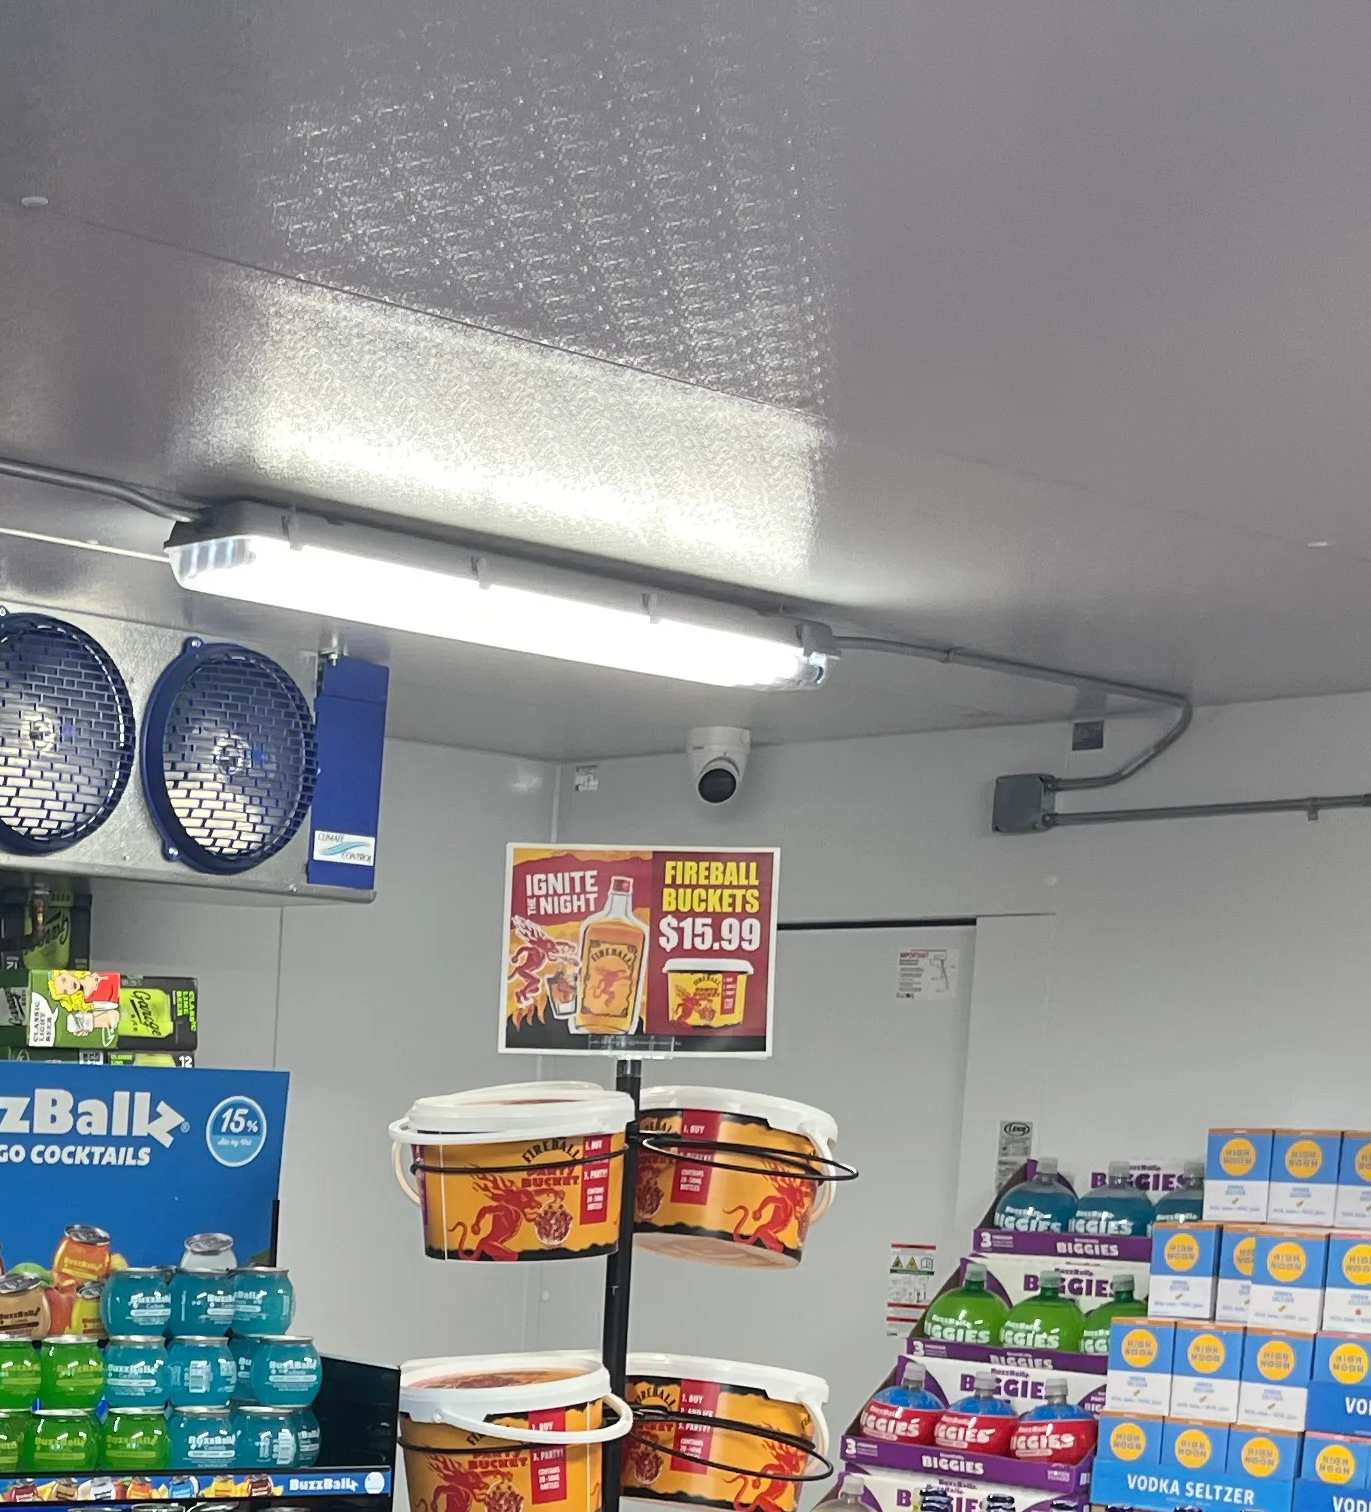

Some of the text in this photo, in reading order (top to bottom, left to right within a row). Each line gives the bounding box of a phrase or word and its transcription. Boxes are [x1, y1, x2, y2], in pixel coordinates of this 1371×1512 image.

[526, 870, 598, 896] IGNITE
[664, 861, 759, 886] FIREBALL
[540, 894, 598, 914] NIGHT
[662, 888, 759, 912] BUCKETS
[659, 915, 760, 952] $15.99
[179, 1056, 192, 1068] 12
[31, 1145, 150, 1166] COCKTAILS
[522, 1137, 583, 1165] FIREBALL
[521, 1175, 580, 1189] BUCKET
[1056, 1241, 1119, 1257] BIGGIES
[922, 1454, 984, 1476] BIGGIES
[1127, 1473, 1255, 1506] VODKA SELTZER
